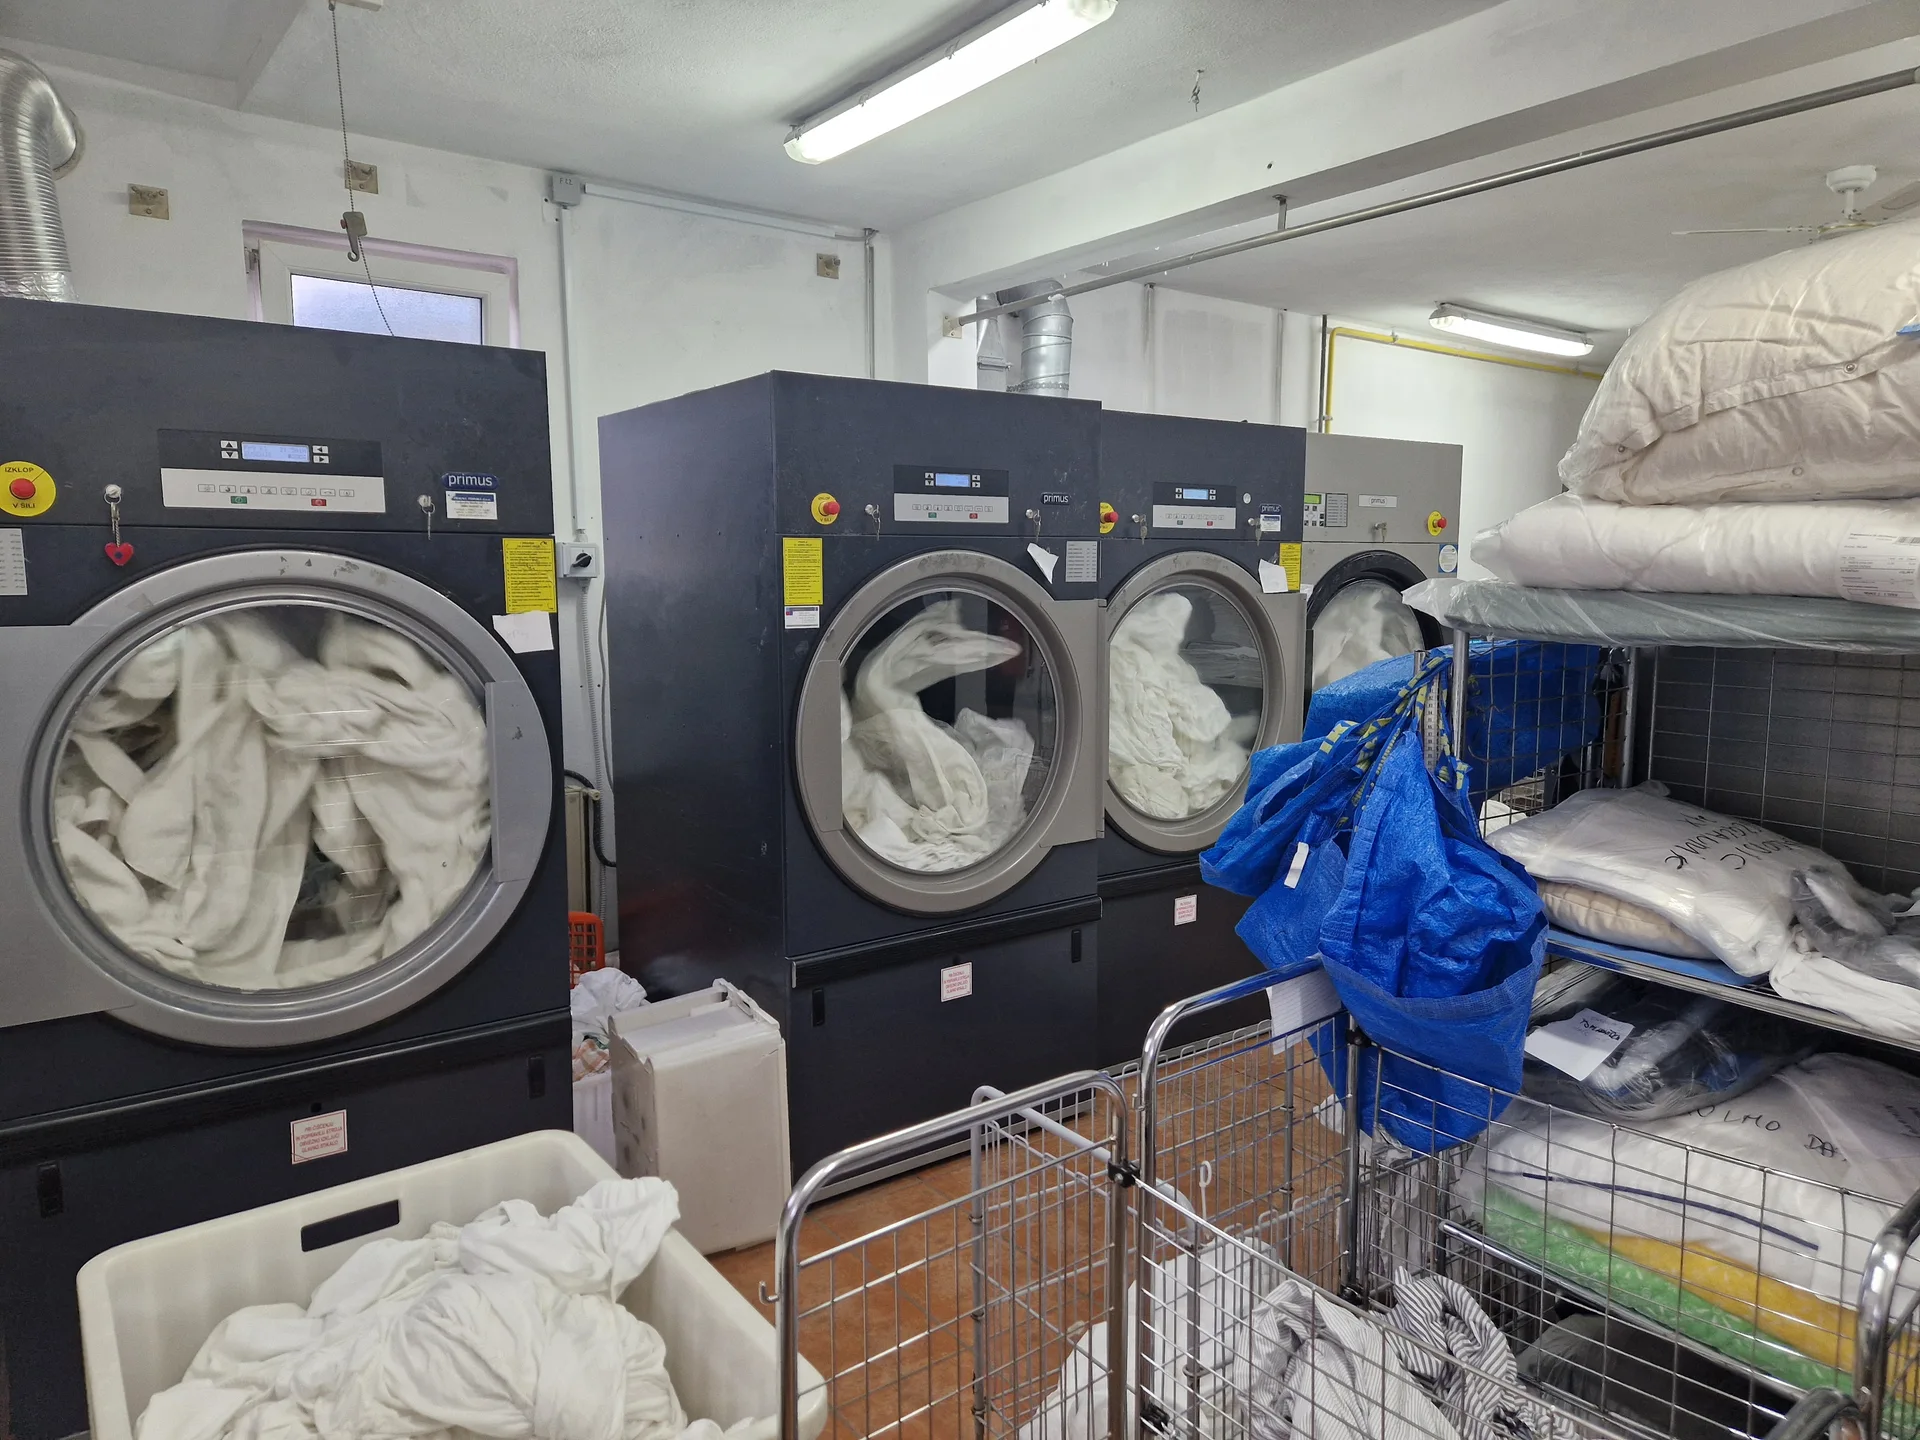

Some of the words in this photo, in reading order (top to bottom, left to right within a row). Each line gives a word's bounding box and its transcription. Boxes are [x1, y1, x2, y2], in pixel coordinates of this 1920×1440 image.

[448, 473, 493, 487] primus
[1043, 492, 1069, 504] primus
[1261, 505, 1280, 513] primus
